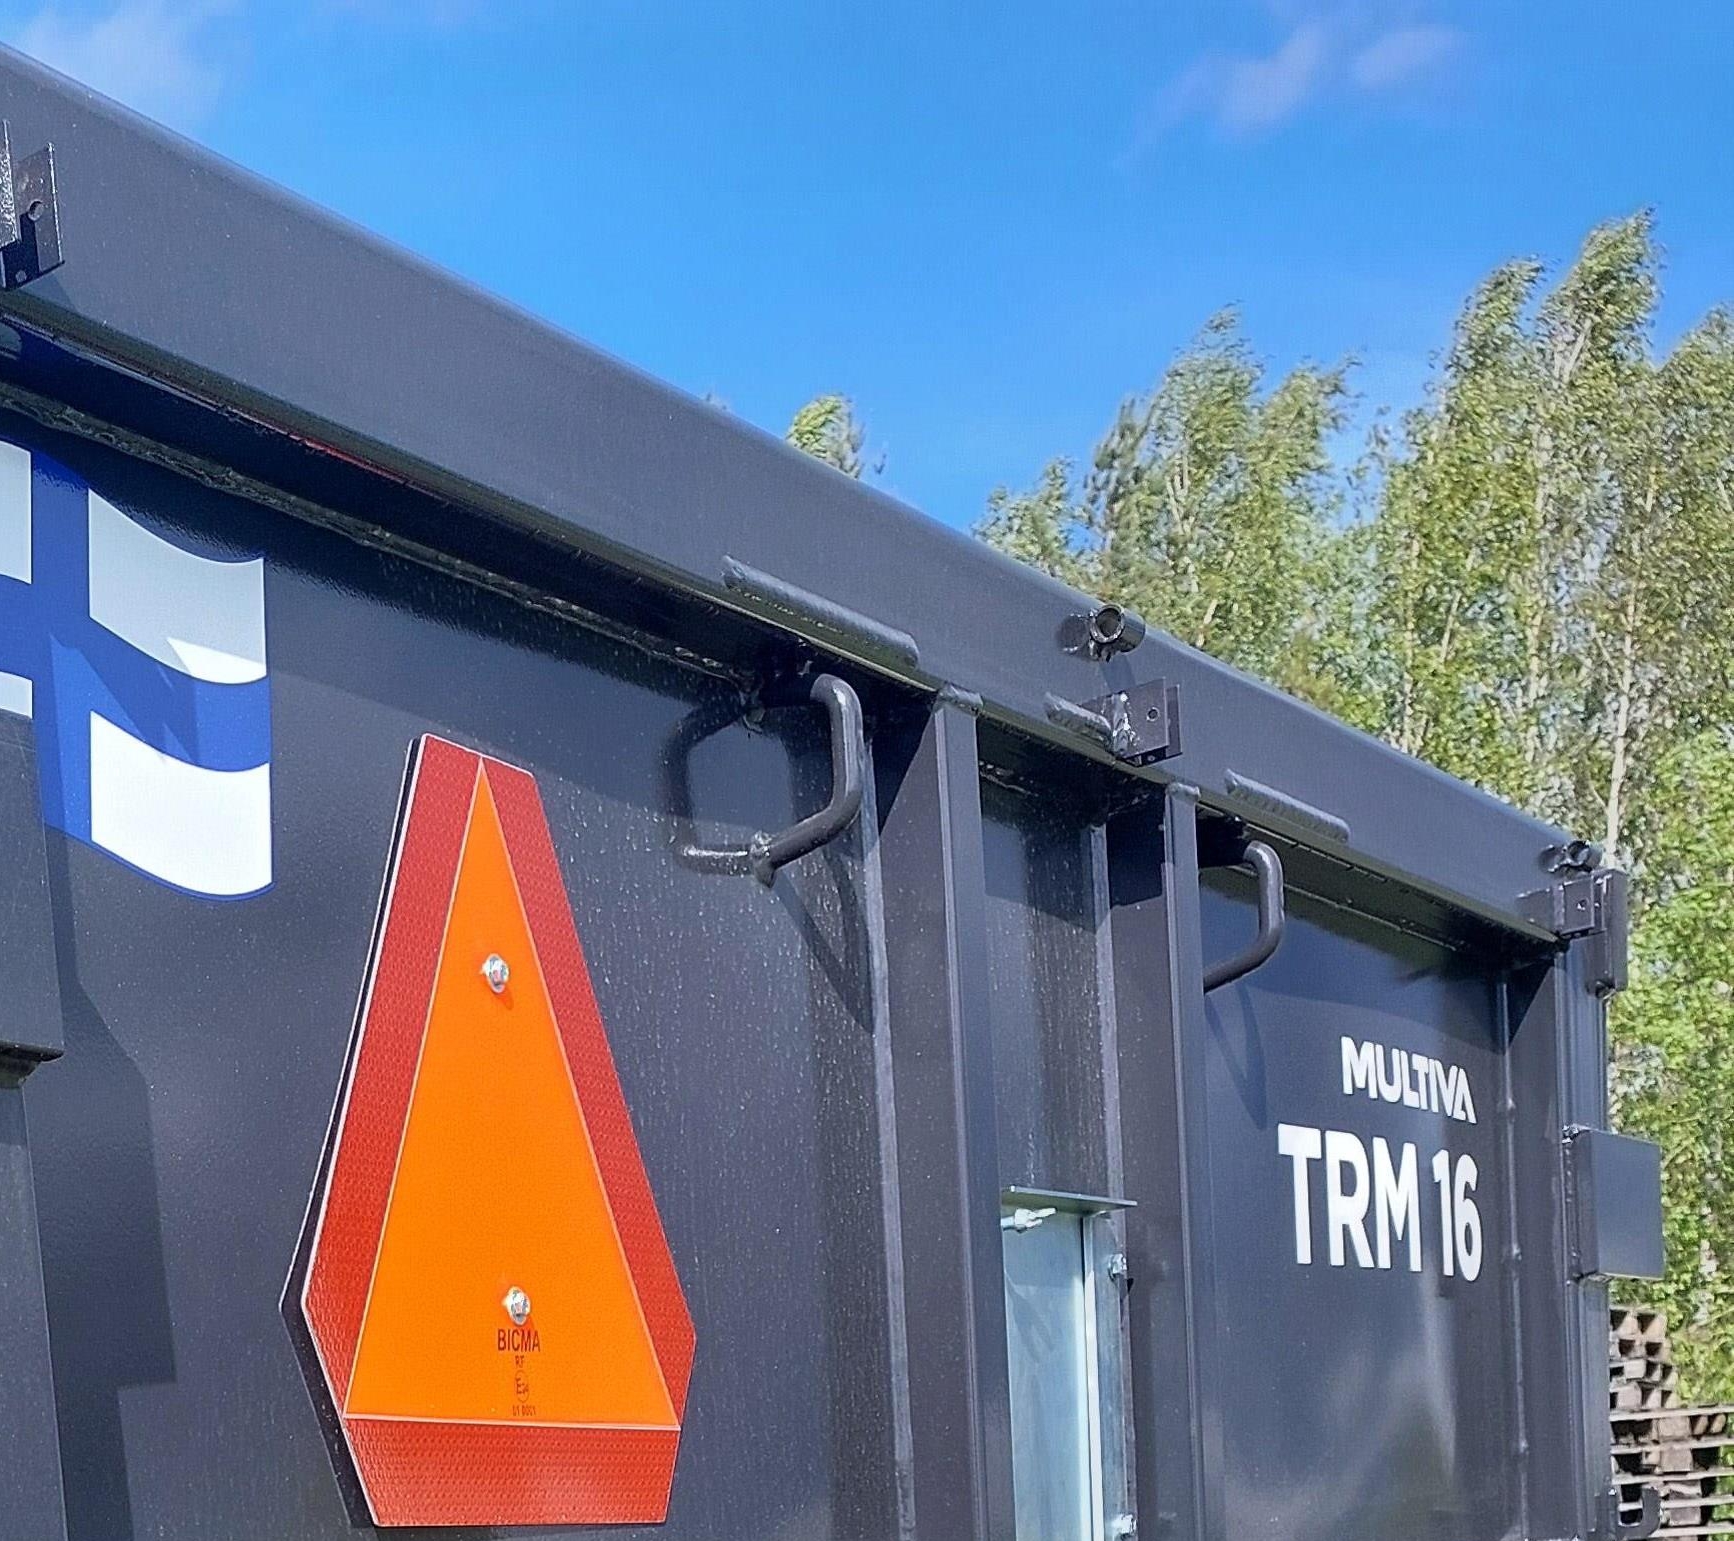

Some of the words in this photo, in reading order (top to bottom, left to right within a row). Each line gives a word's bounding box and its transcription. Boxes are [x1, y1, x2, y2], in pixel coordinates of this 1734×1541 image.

[1340, 1036, 1477, 1124] MULTIVA
[1277, 1123, 1423, 1272] TRM
[1432, 1148, 1483, 1282] 16
[497, 1328, 541, 1352] BICMA
